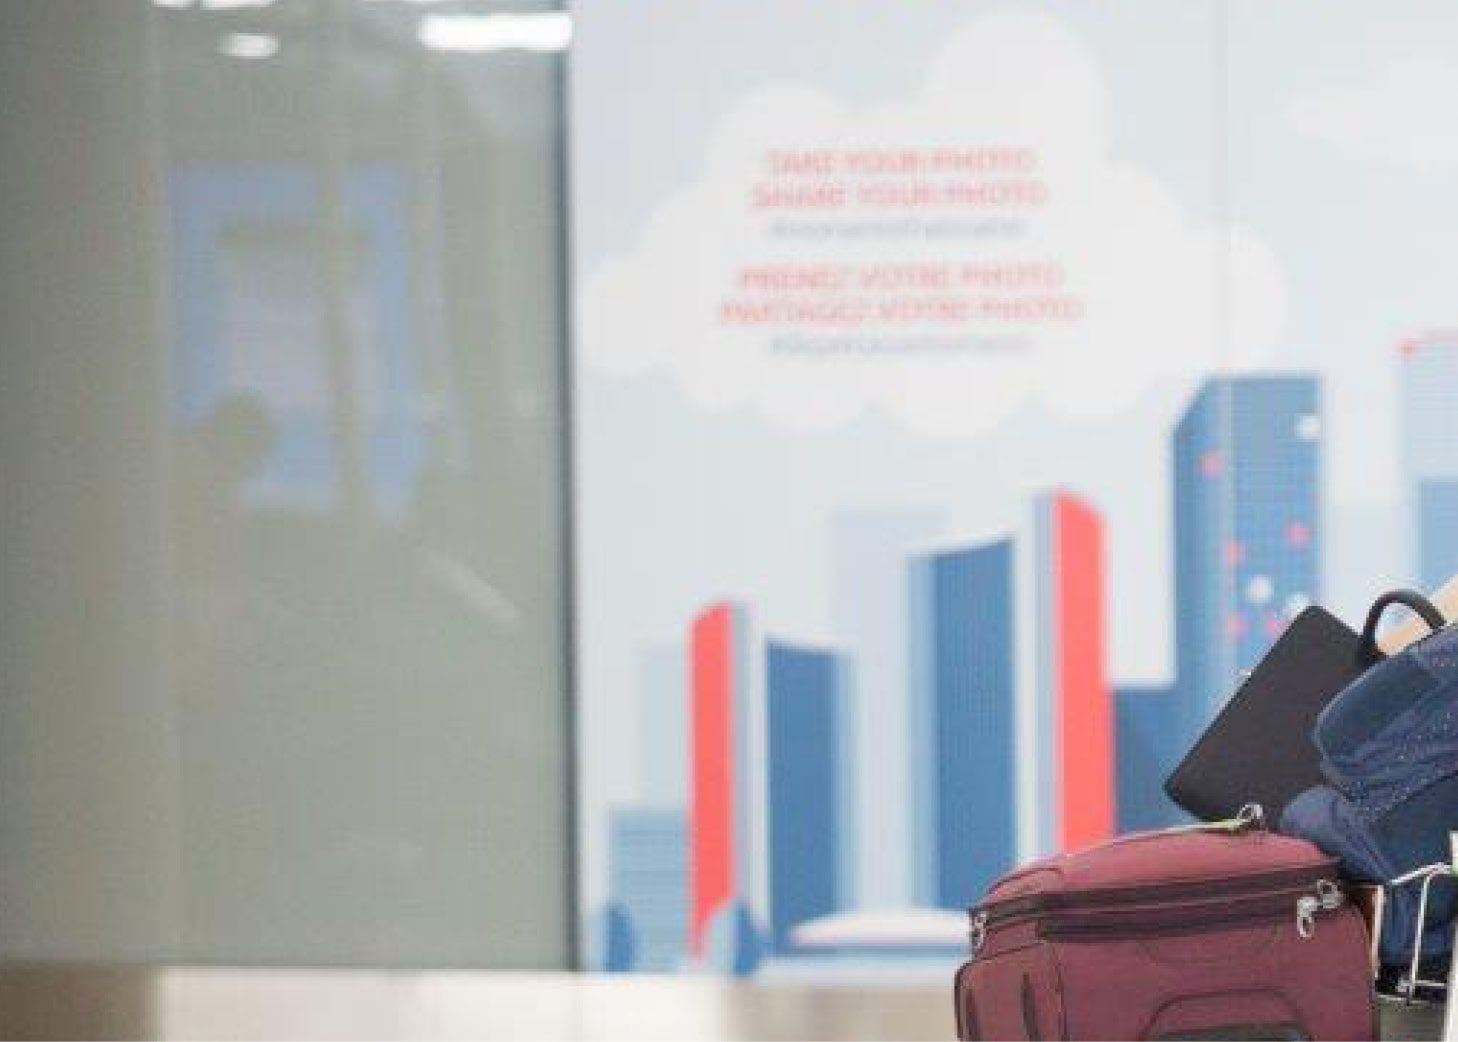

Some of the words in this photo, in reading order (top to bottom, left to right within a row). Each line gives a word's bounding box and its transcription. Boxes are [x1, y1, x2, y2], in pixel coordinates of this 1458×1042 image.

[848, 149, 923, 173] YOUR
[933, 149, 1034, 173] PHOTO
[752, 181, 845, 207] SHARE
[857, 181, 934, 207] YOUR
[945, 181, 1046, 207] PHOTO
[960, 264, 1064, 289] PHOTO
[982, 299, 1084, 325] PHOTO
